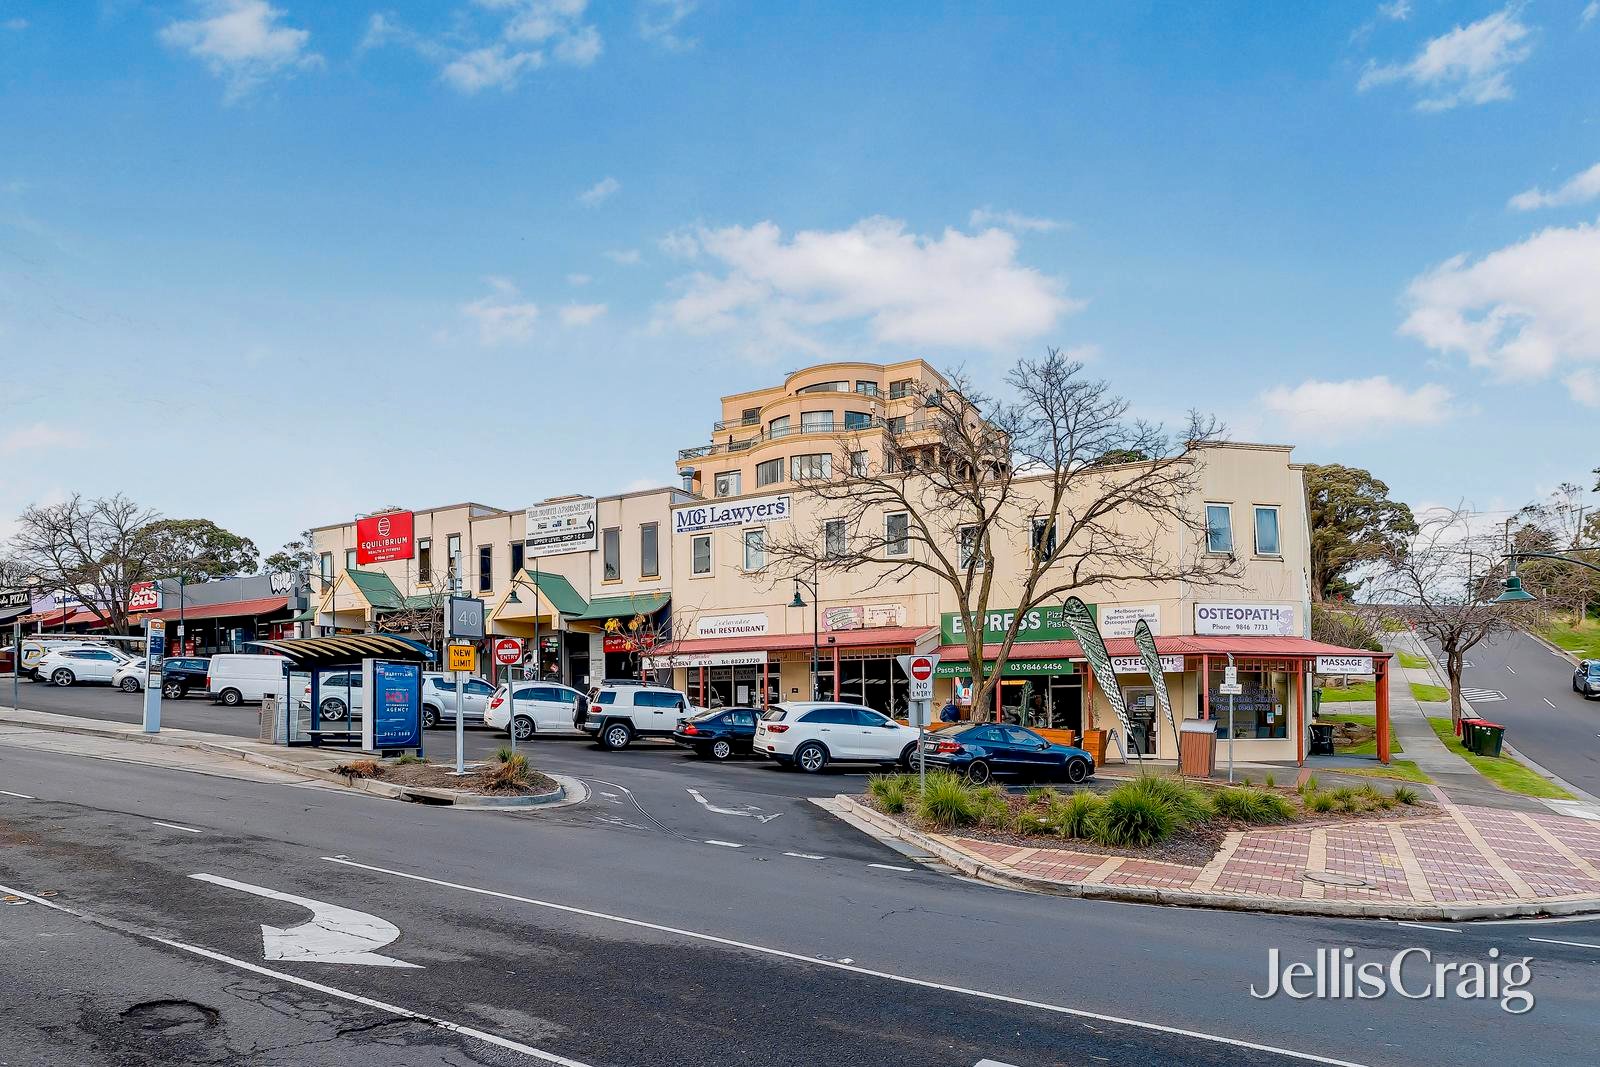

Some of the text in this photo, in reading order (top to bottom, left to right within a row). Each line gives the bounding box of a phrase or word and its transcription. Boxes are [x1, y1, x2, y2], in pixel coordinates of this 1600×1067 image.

[710, 501, 786, 523] Lawyers
[361, 536, 408, 550] EQUILIBRIUM
[9, 593, 28, 605] PIZZA
[458, 610, 478, 627] 40
[1198, 608, 1280, 621] OSTEOPATH
[1046, 620, 1067, 629] Past
[1212, 623, 1231, 631] Phone
[718, 625, 766, 634] RESTAURANT
[453, 649, 471, 657] NEW
[1010, 662, 1063, 671] 03 9846 4456
[1114, 658, 1174, 666] OSTEOTH
[1321, 658, 1362, 667] MASSAGE
[912, 690, 932, 698] ENTRY
